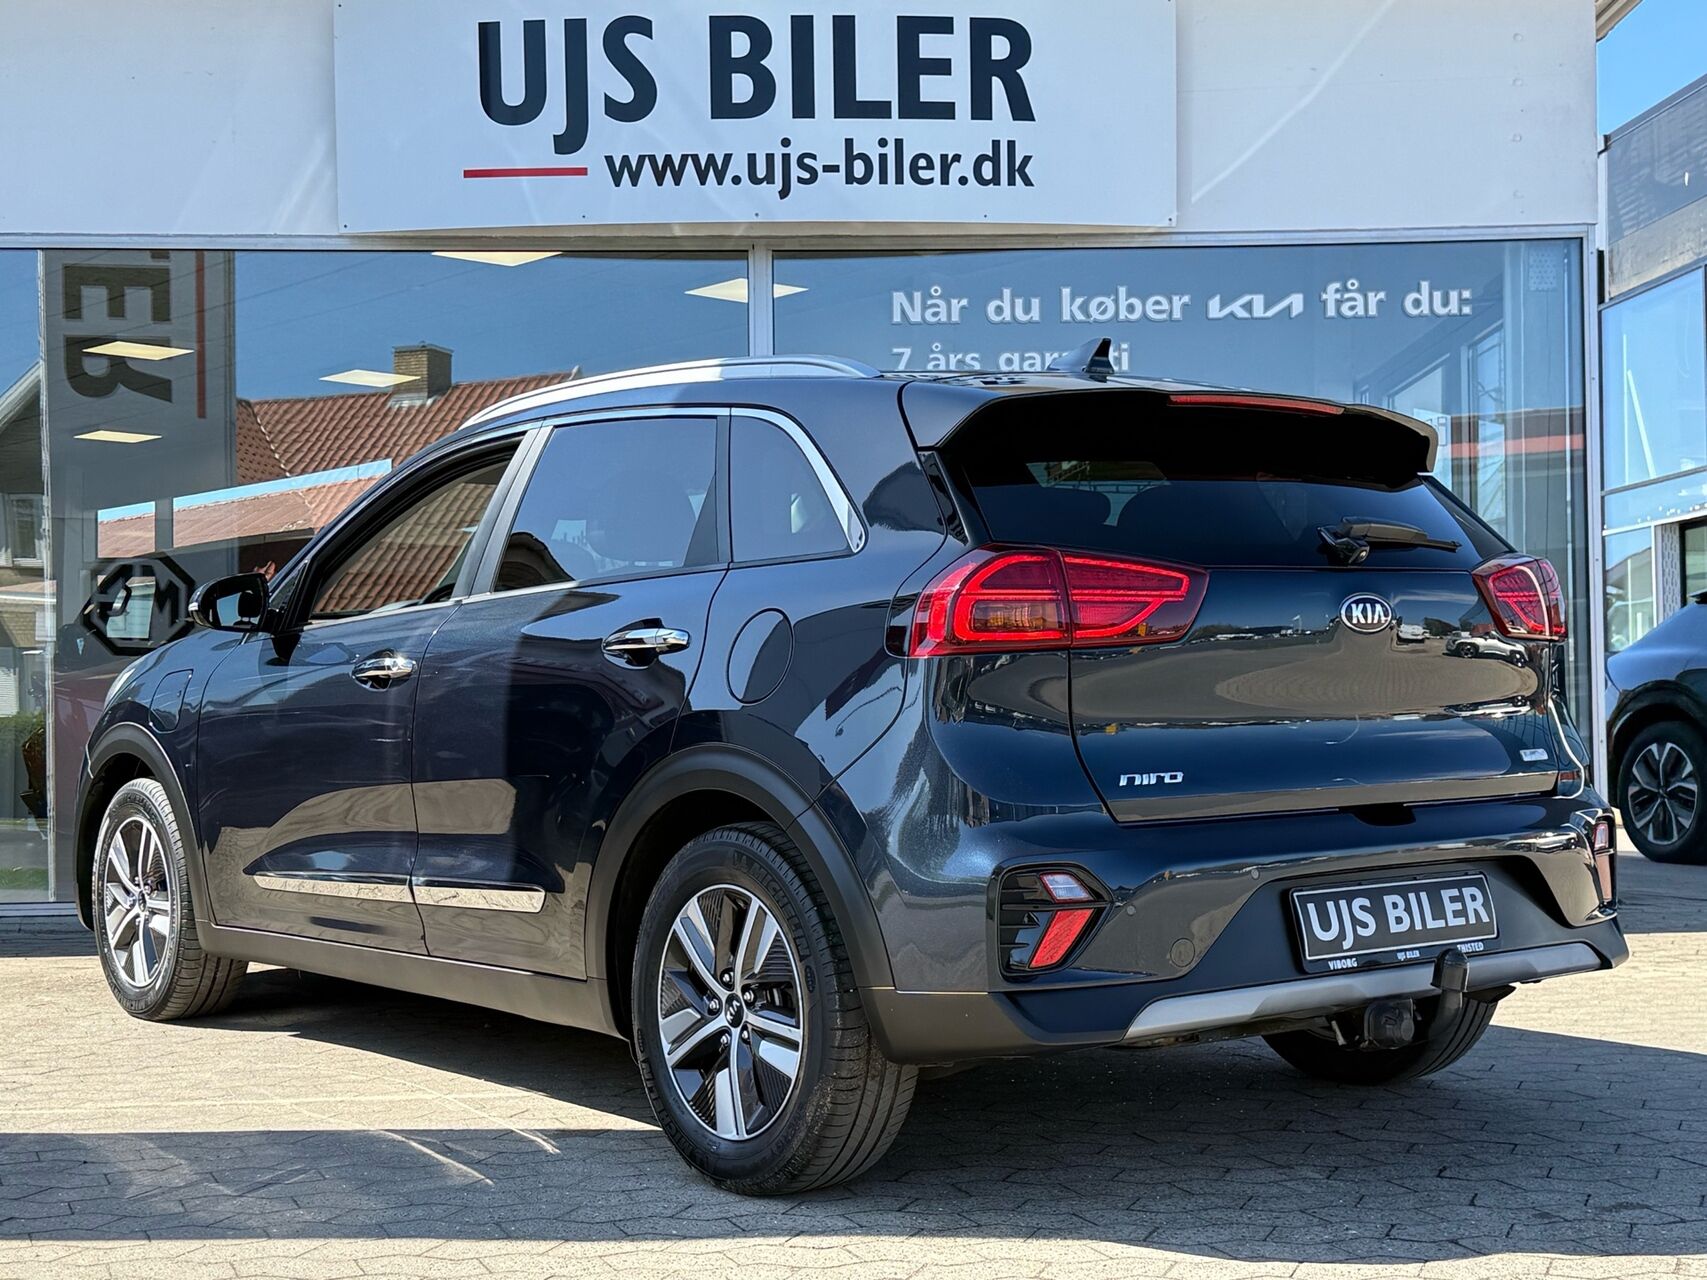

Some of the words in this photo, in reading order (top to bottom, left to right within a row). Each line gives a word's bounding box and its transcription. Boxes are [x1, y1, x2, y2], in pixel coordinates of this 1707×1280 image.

[478, 15, 658, 155] UJS
[708, 15, 1036, 121] BILER
[604, 137, 1035, 200] www.ujs-biler.dk
[891, 285, 968, 325] Når
[986, 288, 1041, 323] du
[1060, 286, 1191, 323] køber
[1320, 278, 1386, 318] får
[1404, 280, 1472, 316] du:
[892, 348, 912, 371] 7
[926, 343, 981, 371] års
[999, 343, 1129, 372] garti
[1351, 602, 1386, 624] KIA
[1306, 897, 1377, 950] UJS
[1383, 886, 1490, 934] BILER
[1328, 958, 1358, 970] VIBORG
[1457, 941, 1484, 954] THISTED
